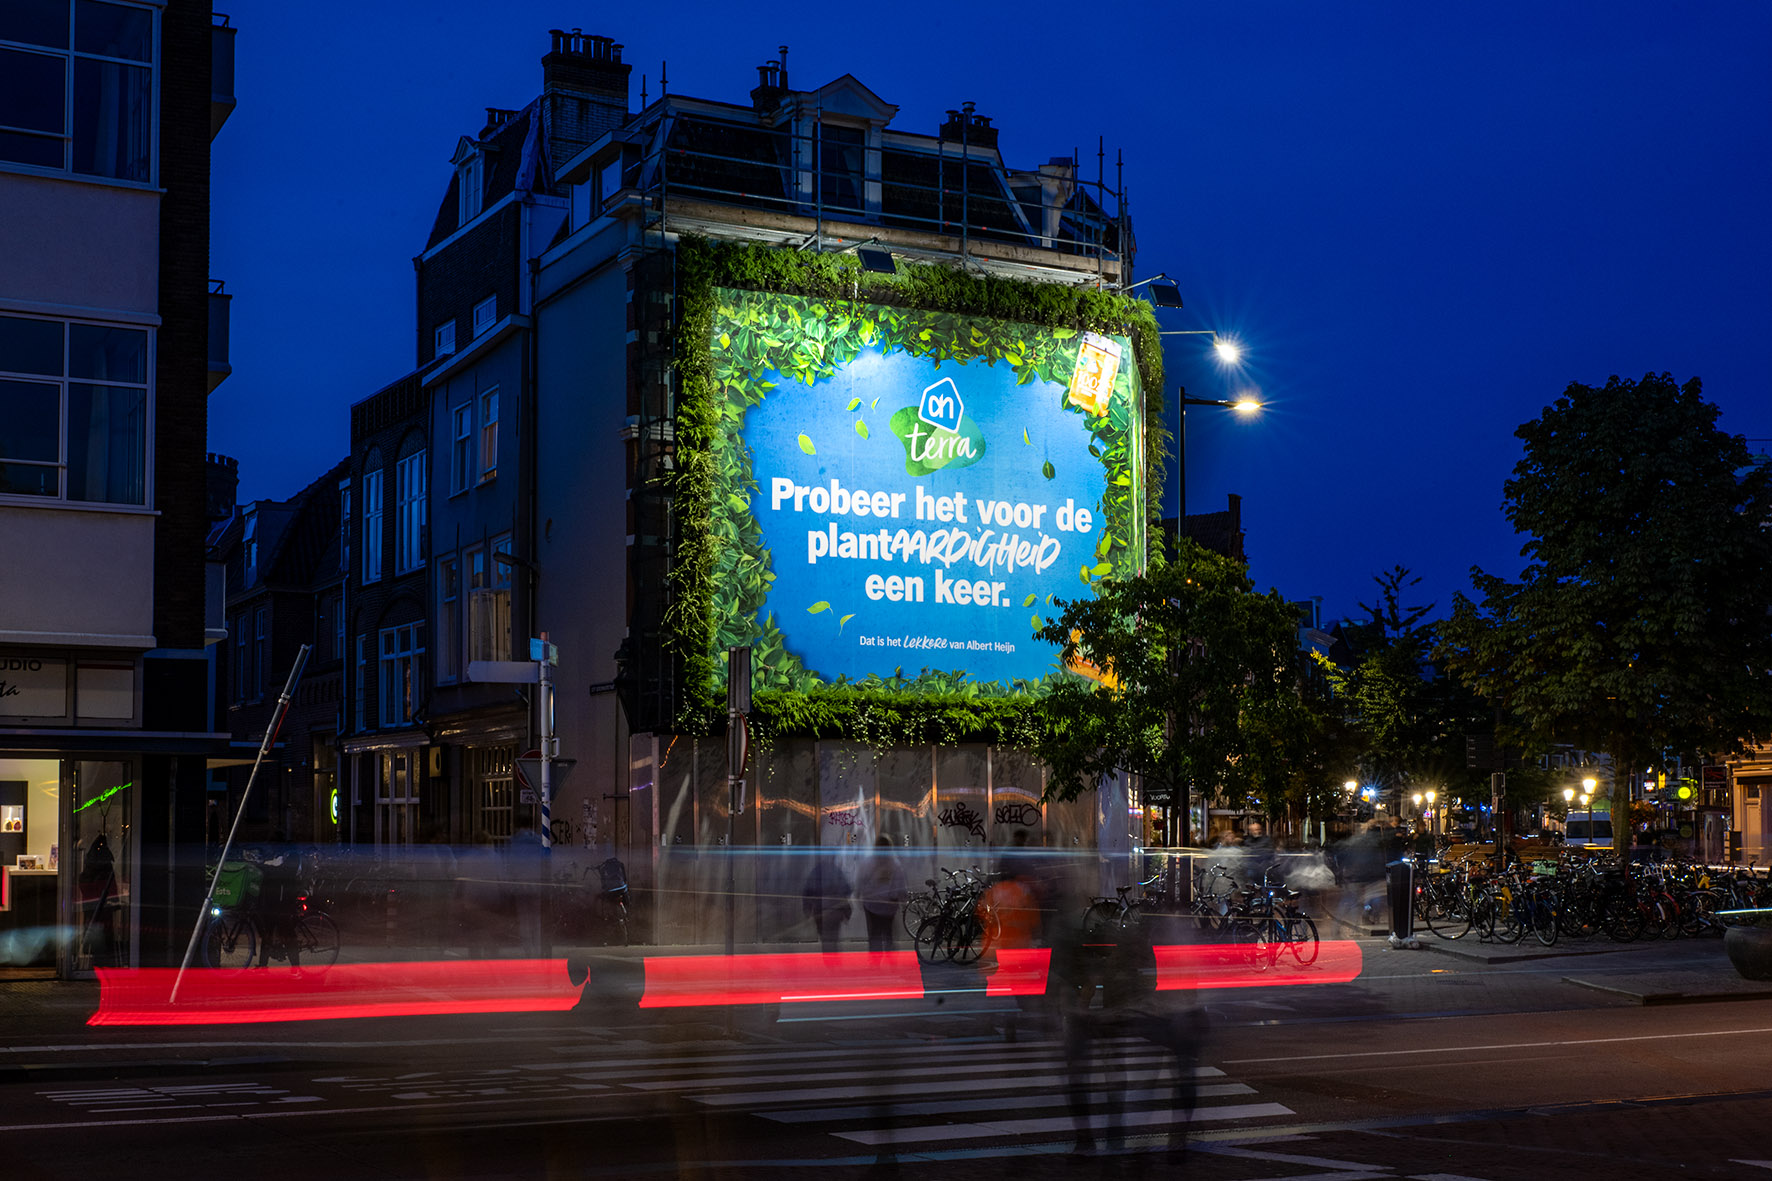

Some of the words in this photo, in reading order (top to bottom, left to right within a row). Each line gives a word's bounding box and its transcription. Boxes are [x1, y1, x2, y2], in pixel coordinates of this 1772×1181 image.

[904, 422, 977, 462] terra
[771, 477, 906, 518] Probeer
[915, 485, 968, 523] het
[976, 499, 1047, 529] voor
[1055, 498, 1093, 533] de
[865, 573, 924, 602] een
[934, 569, 1011, 607] keer.
[859, 635, 876, 646] Dat
[877, 635, 885, 646] is
[886, 636, 901, 647] het
[949, 641, 965, 650] van
[966, 640, 993, 651] Albert
[994, 642, 1016, 654] Heijn
